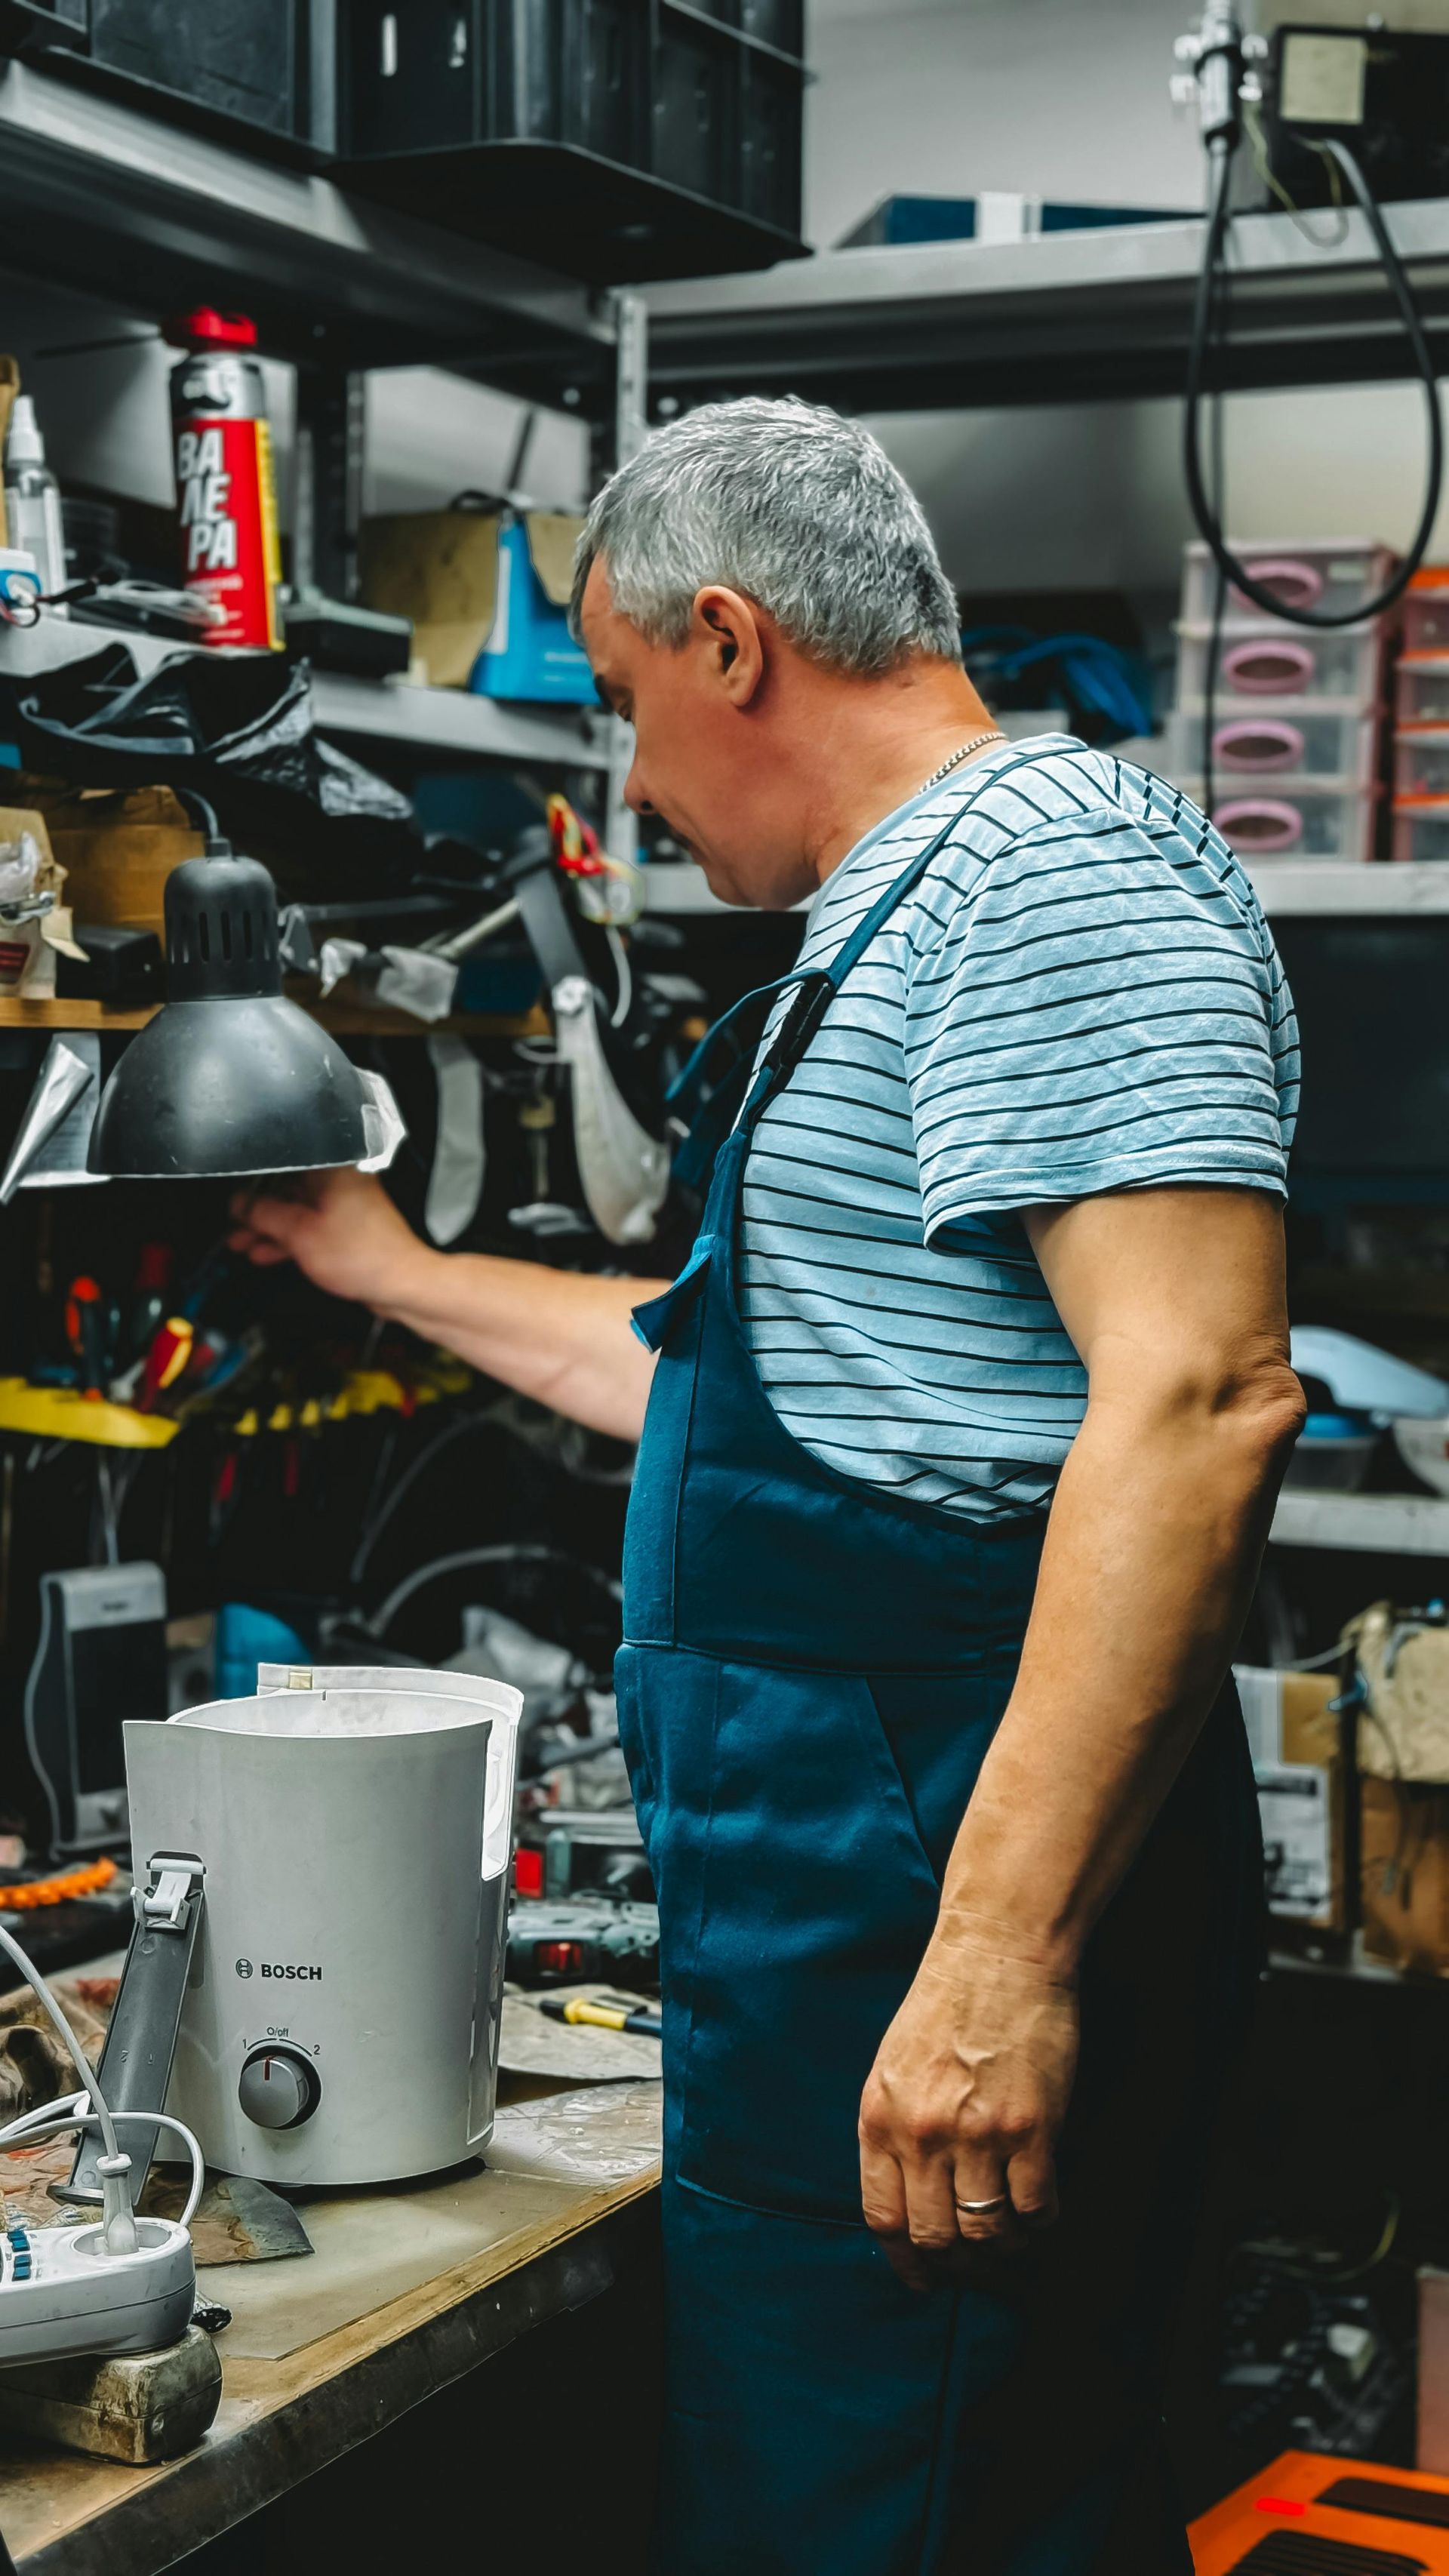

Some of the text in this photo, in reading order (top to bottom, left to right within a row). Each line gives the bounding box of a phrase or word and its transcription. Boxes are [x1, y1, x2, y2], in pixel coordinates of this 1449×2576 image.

[261, 1963, 322, 1980] BOSCH
[242, 2039, 247, 2049] 1
[313, 2044, 321, 2055] 2
